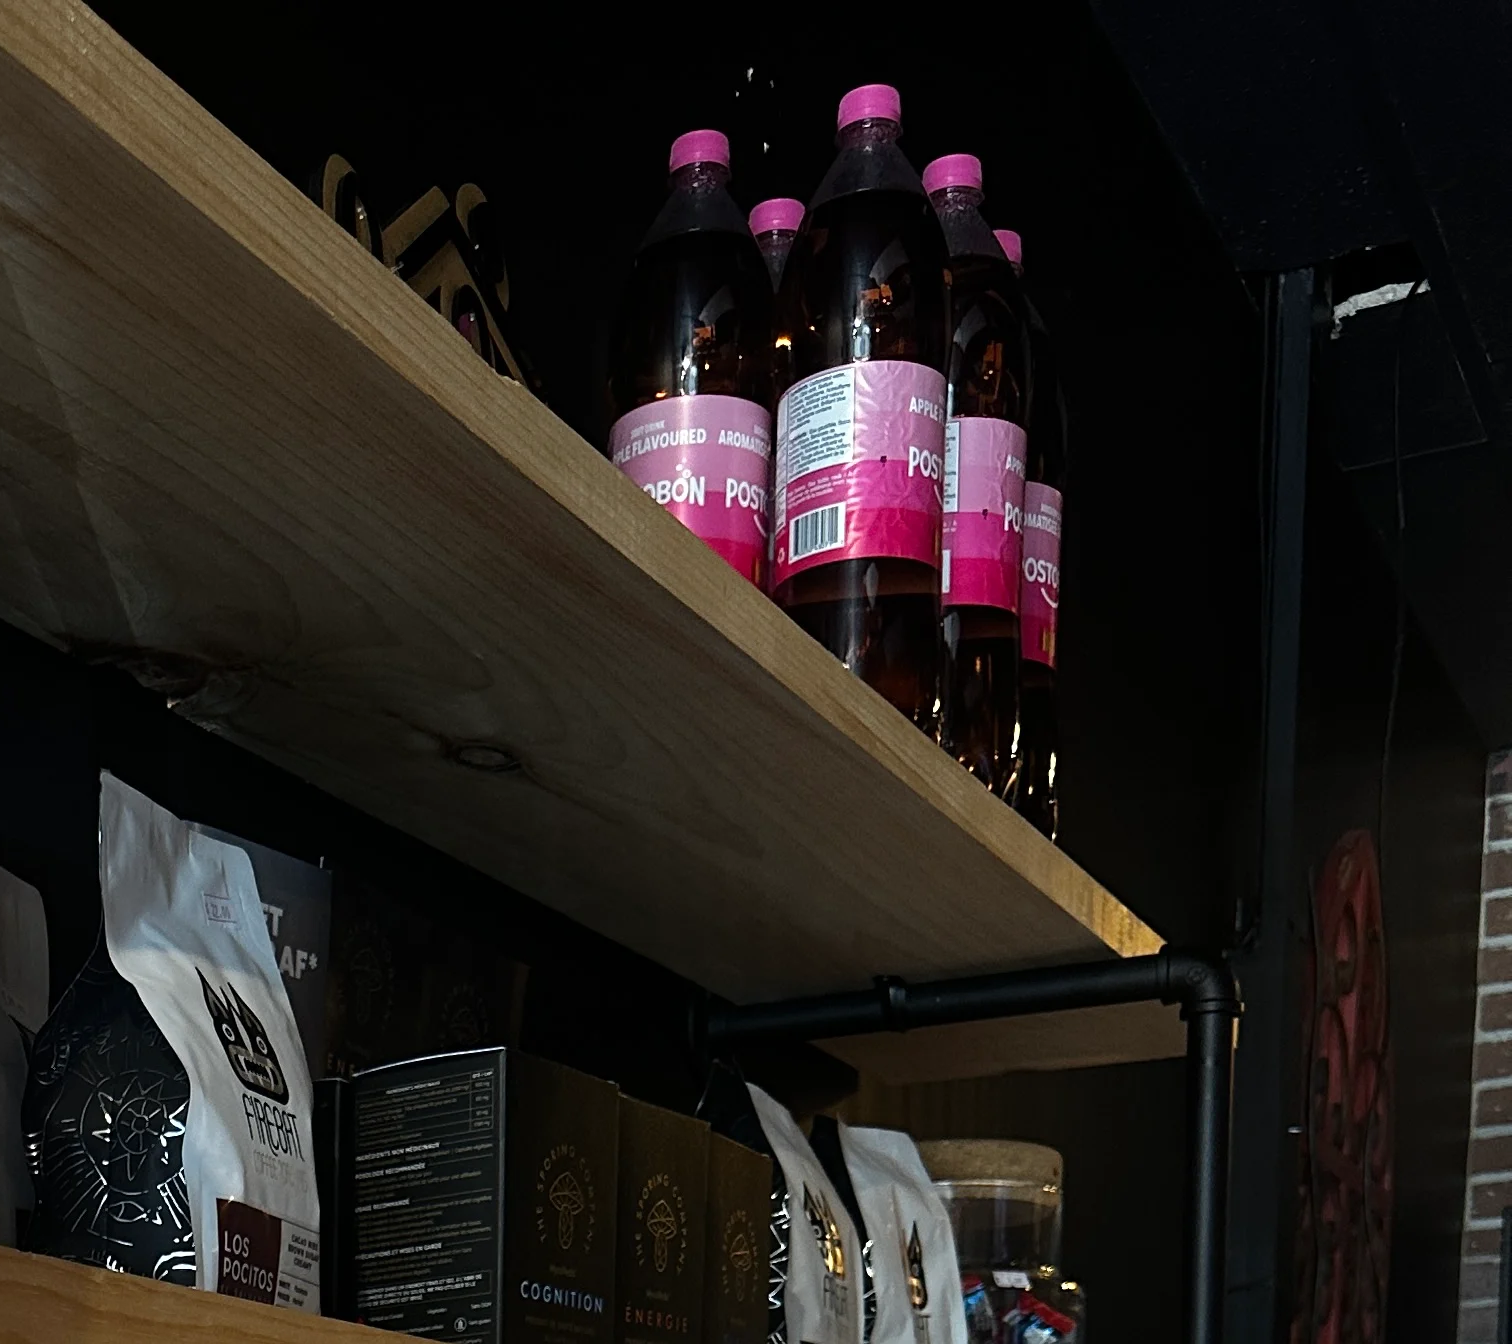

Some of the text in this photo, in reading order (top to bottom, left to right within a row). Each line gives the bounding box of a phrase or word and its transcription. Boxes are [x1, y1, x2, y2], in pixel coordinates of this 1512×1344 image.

[633, 428, 706, 456] FLAVOURED
[224, 1230, 250, 1258] LOS
[223, 1258, 274, 1293] POCITOS
[520, 1279, 604, 1314] COGNITION
[624, 1301, 688, 1334] ÉNERGIE
